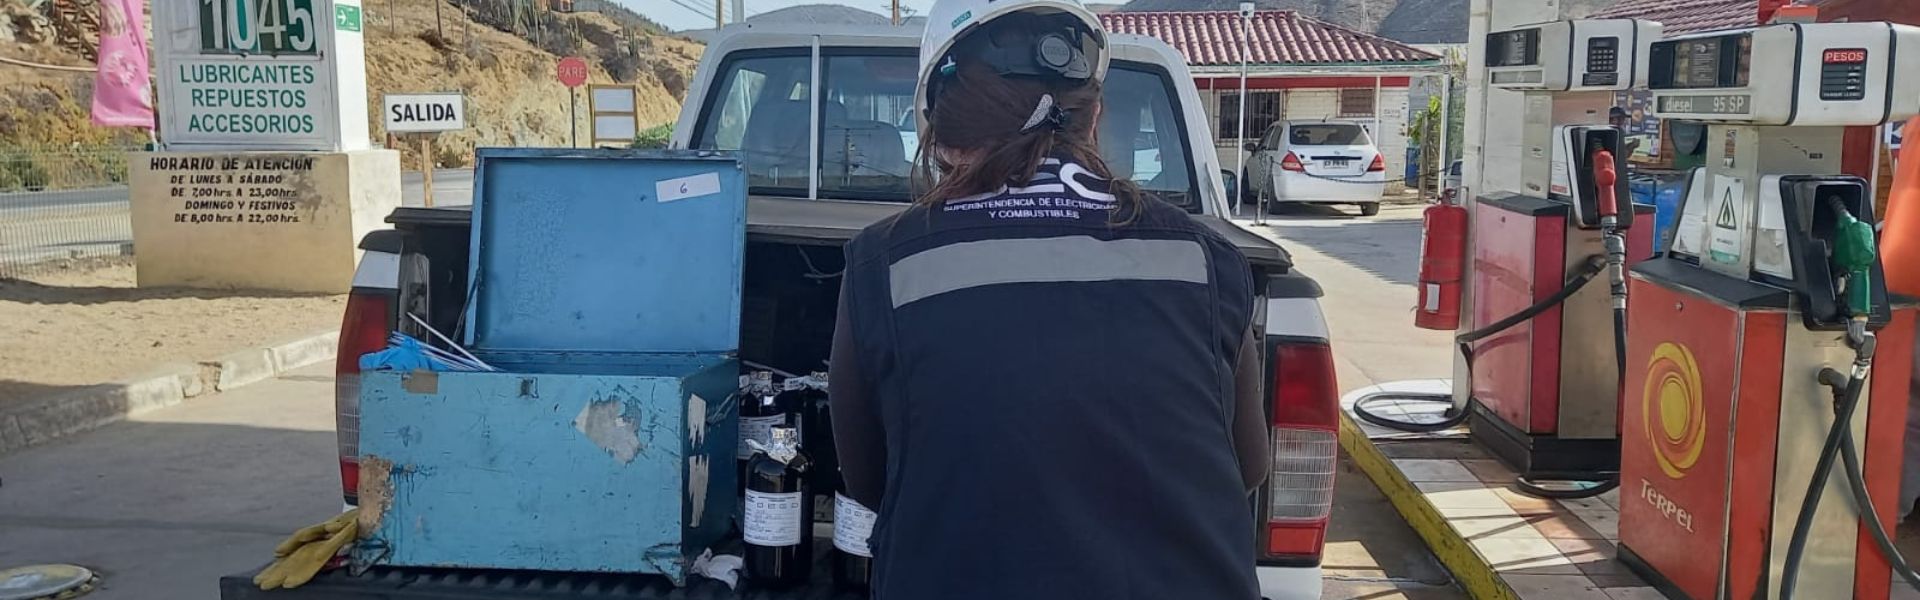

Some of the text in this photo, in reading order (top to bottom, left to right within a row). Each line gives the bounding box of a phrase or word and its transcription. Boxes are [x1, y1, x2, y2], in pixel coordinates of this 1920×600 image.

[202, 0, 314, 51] 1045
[1824, 52, 1864, 62] PESOS
[180, 64, 314, 84] LUBRICANTES
[559, 66, 586, 78] PARE
[191, 89, 306, 108] REPUESTOS
[1665, 95, 1745, 112] diesel 95 SP
[392, 103, 456, 122] SALIDA
[188, 114, 314, 133] ACCESORIOS
[150, 157, 214, 170] HORARIO
[221, 157, 239, 170] DE
[171, 174, 185, 184] DE
[190, 174, 222, 184] LUNES
[227, 174, 233, 184] A
[171, 187, 185, 197] DE
[236, 187, 242, 197] A
[680, 182, 688, 194] 6
[185, 200, 296, 210] DOMINGO Y FESTIVOS
[943, 198, 1035, 212] SUPERINTENDENCIA
[1038, 197, 1052, 207] DE
[174, 213, 188, 223] DE
[236, 213, 243, 222] A
[988, 209, 1081, 220] Y COMBUSTIBLES
